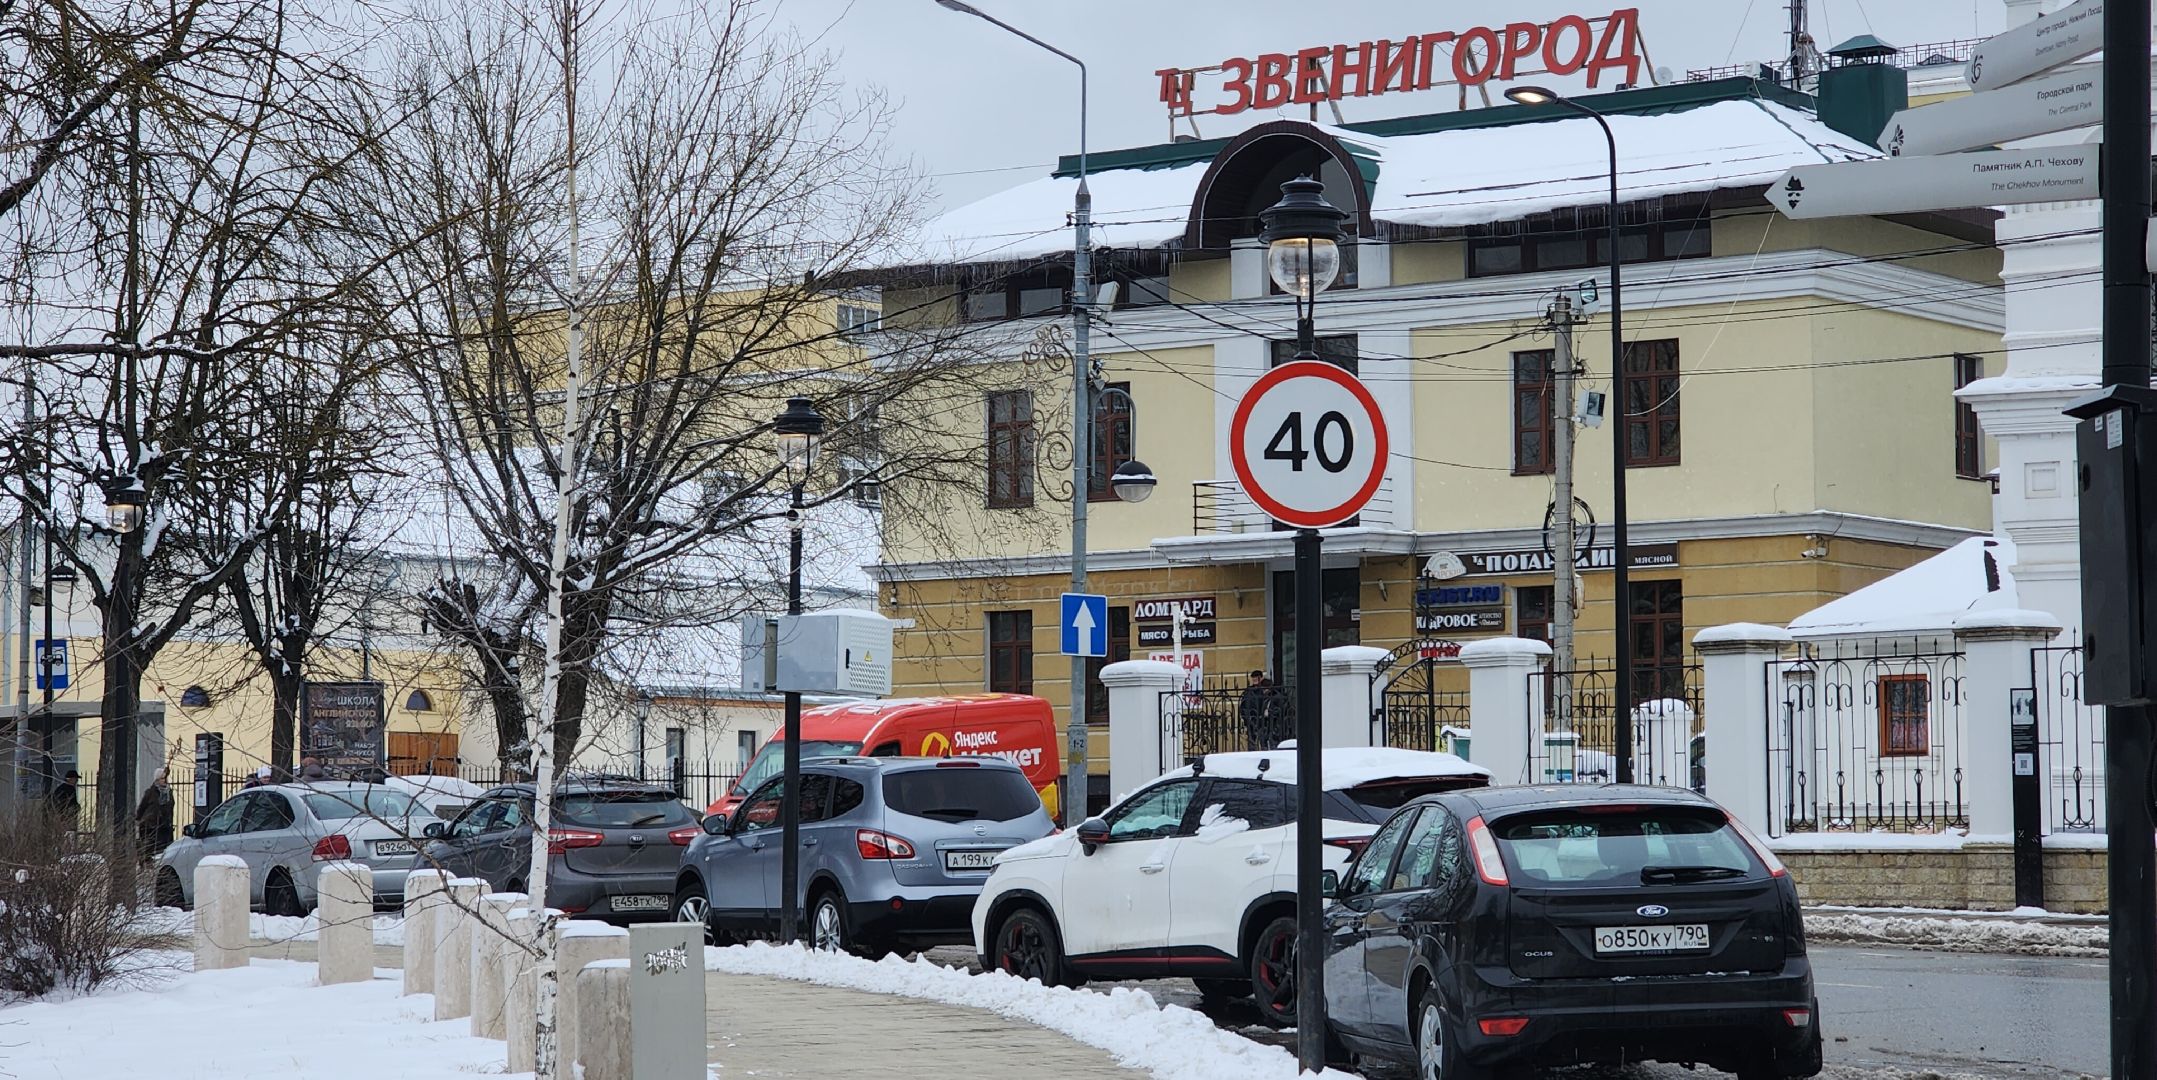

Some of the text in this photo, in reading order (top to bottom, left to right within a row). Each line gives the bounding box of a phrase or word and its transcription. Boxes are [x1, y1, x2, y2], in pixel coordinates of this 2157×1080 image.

[1155, 8, 1640, 116] ТЦ ЗВЕНИГОРОД
[2037, 81, 2094, 101] Городской парк
[2048, 101, 2093, 117] The Central Park
[1973, 156, 2085, 173] Памятник А.П. Чехову
[1991, 176, 2085, 192] The Chekhov Monument
[1264, 410, 1354, 473] 40
[1486, 547, 1616, 572] ПОГАРКИ
[1634, 554, 1673, 565] МЯСНОЙ
[1141, 630, 1168, 641] МЯСО
[1182, 629, 1211, 639] РЫБА
[338, 696, 376, 706] ШКОЛА
[954, 731, 998, 749] Яндекс
[653, 895, 667, 904] 790
[1644, 907, 1662, 915] Ford
[1602, 926, 1704, 948] О850КУ 790
